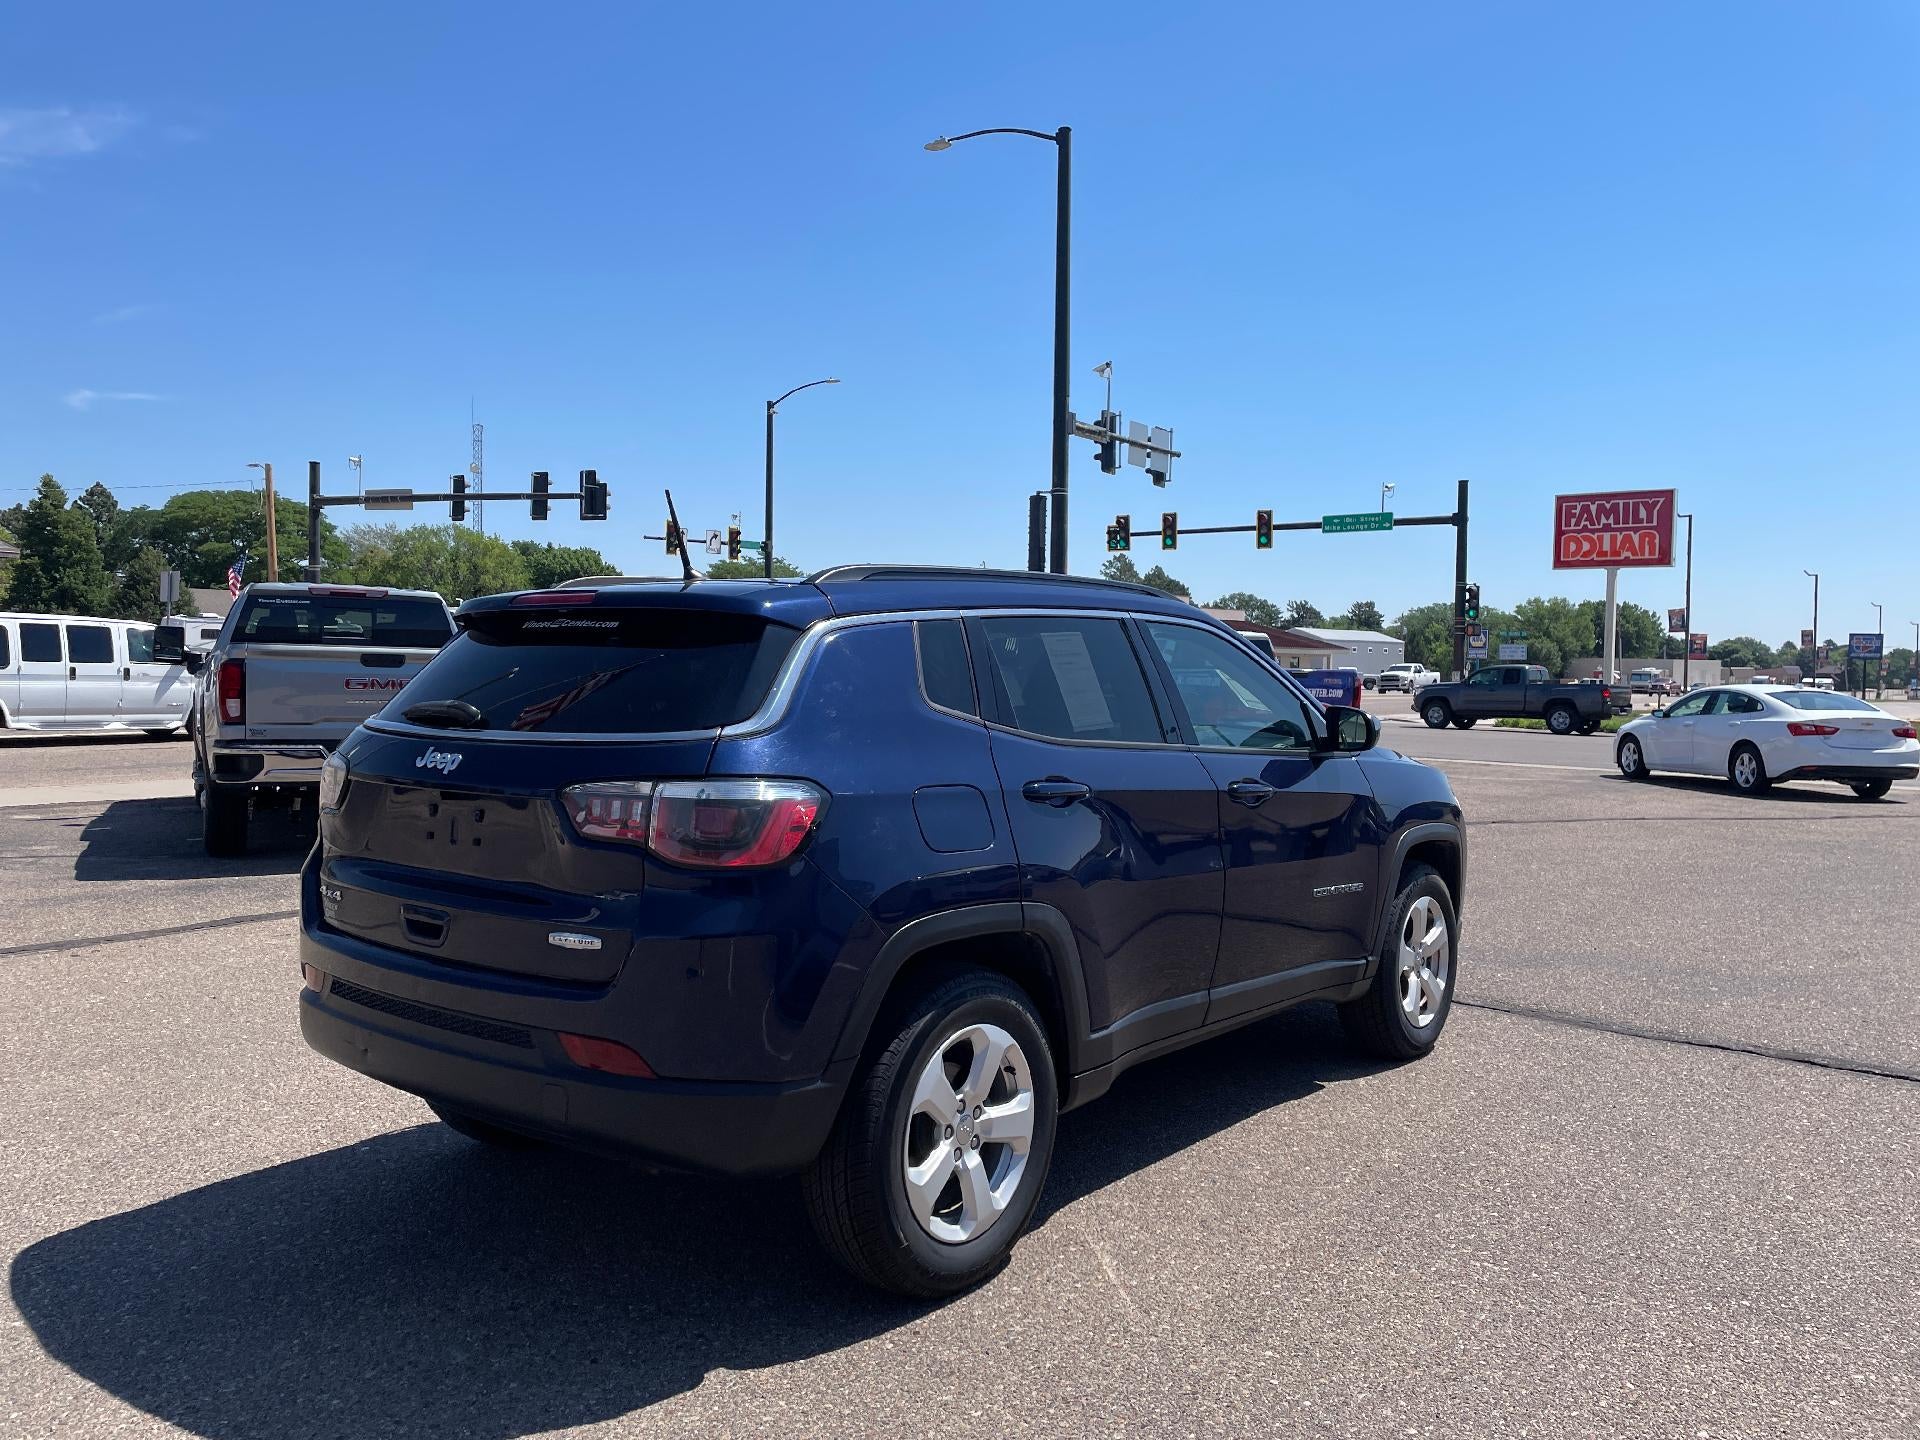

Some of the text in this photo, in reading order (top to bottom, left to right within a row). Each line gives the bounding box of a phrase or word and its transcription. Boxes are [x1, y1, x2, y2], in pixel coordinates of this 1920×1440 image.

[1562, 498, 1665, 530] FAMILY
[1561, 530, 1660, 561] DOLLAR
[415, 746, 462, 775] Jeep
